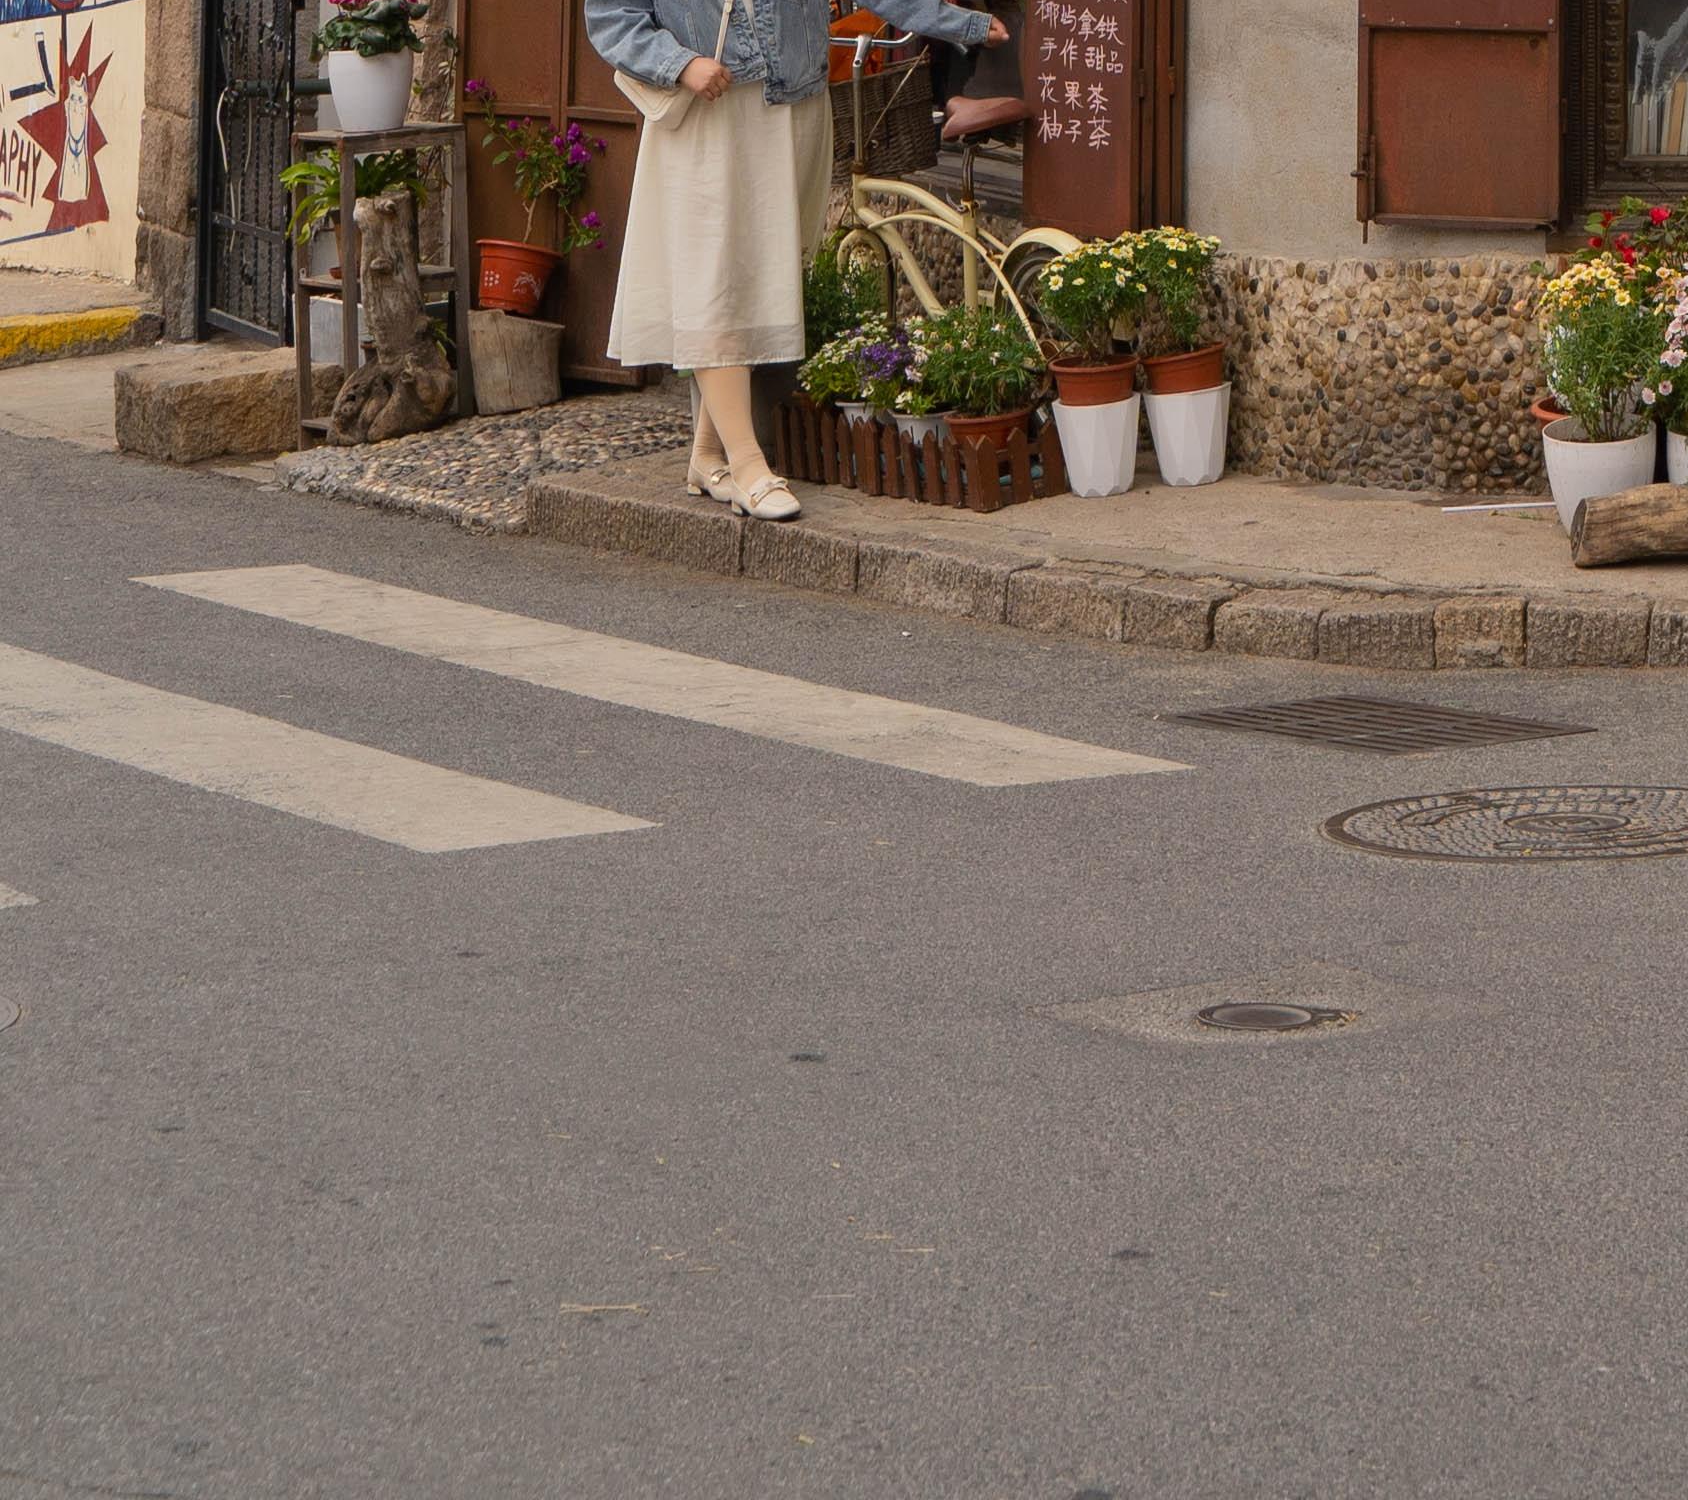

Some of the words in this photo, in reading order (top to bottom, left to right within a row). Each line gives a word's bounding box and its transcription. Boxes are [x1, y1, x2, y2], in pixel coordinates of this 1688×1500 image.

[1039, 37, 1124, 74] 手作甜品
[1037, 72, 1109, 116] 花果茶
[1037, 107, 1112, 151] 柚子茶
